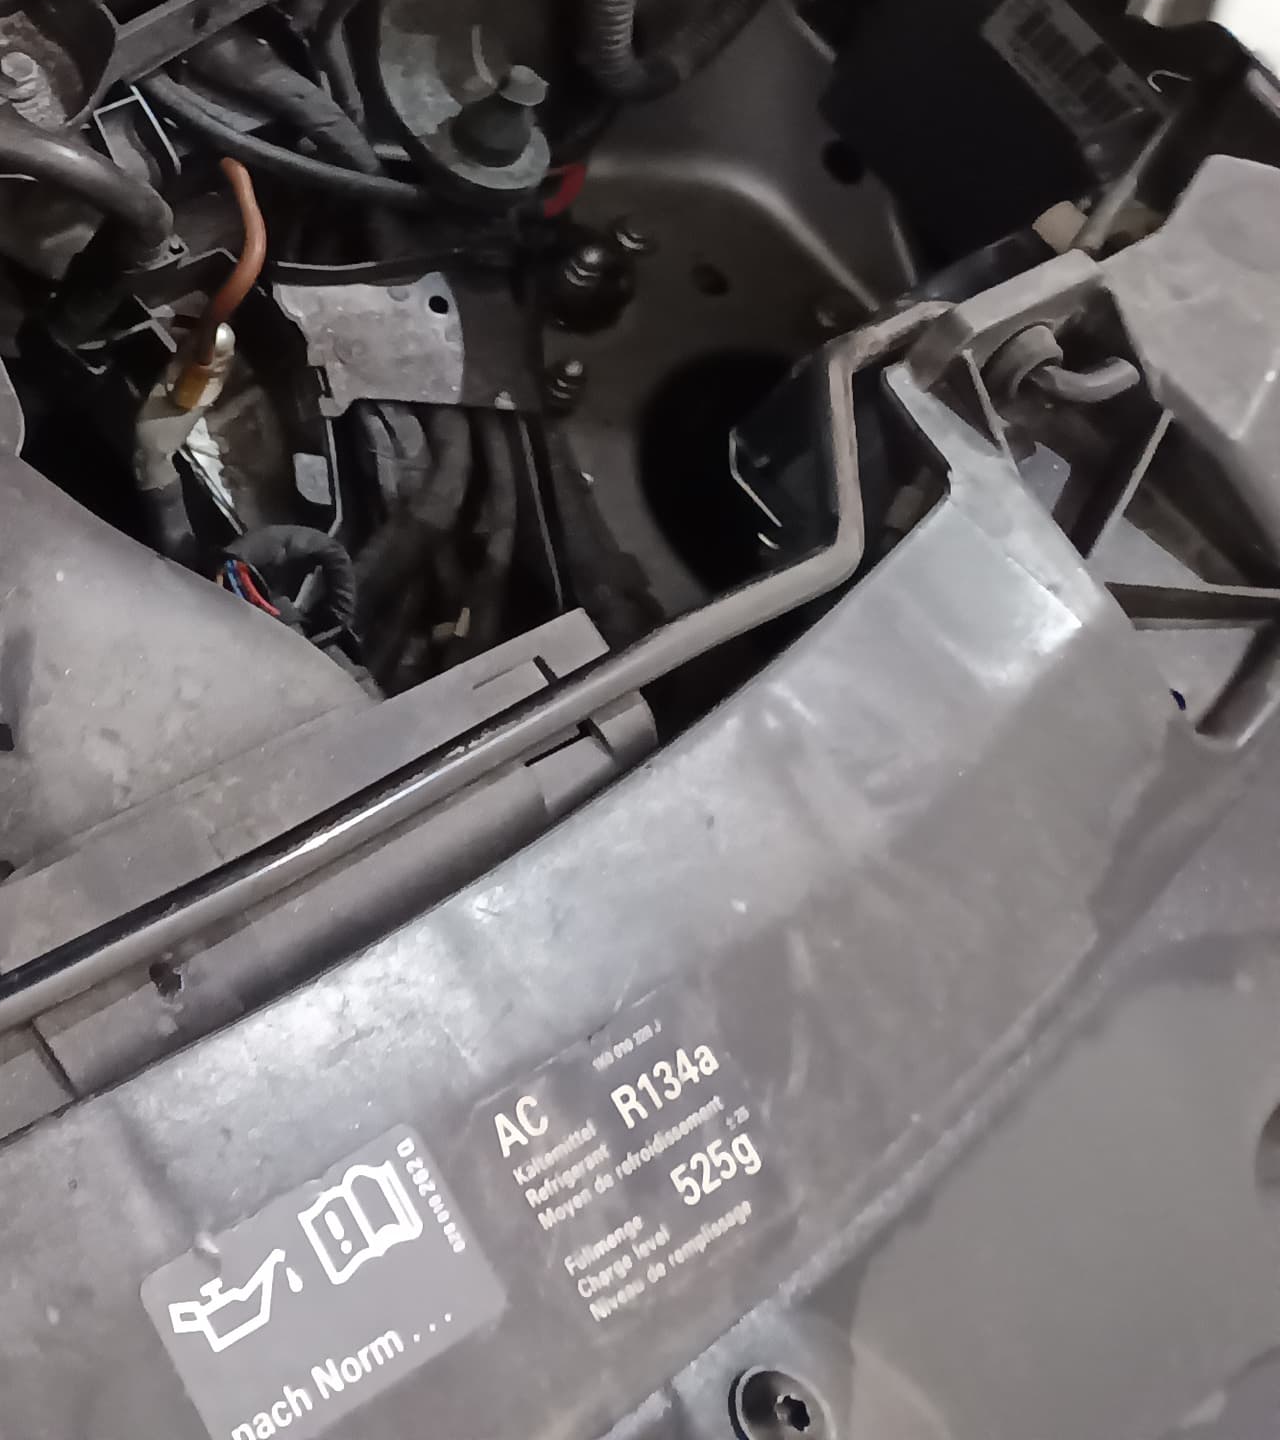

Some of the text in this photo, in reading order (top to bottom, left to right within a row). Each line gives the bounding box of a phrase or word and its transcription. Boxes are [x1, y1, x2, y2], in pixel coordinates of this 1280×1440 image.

[493, 1044, 720, 1158] AC R134a
[524, 1141, 610, 1209] Refrigerant
[537, 1095, 726, 1231] Moyen de refroidissement
[669, 1132, 763, 1206] 525g
[576, 1222, 672, 1299] Charge level
[231, 1384, 313, 1440] nach
[310, 1329, 405, 1401] Norm
